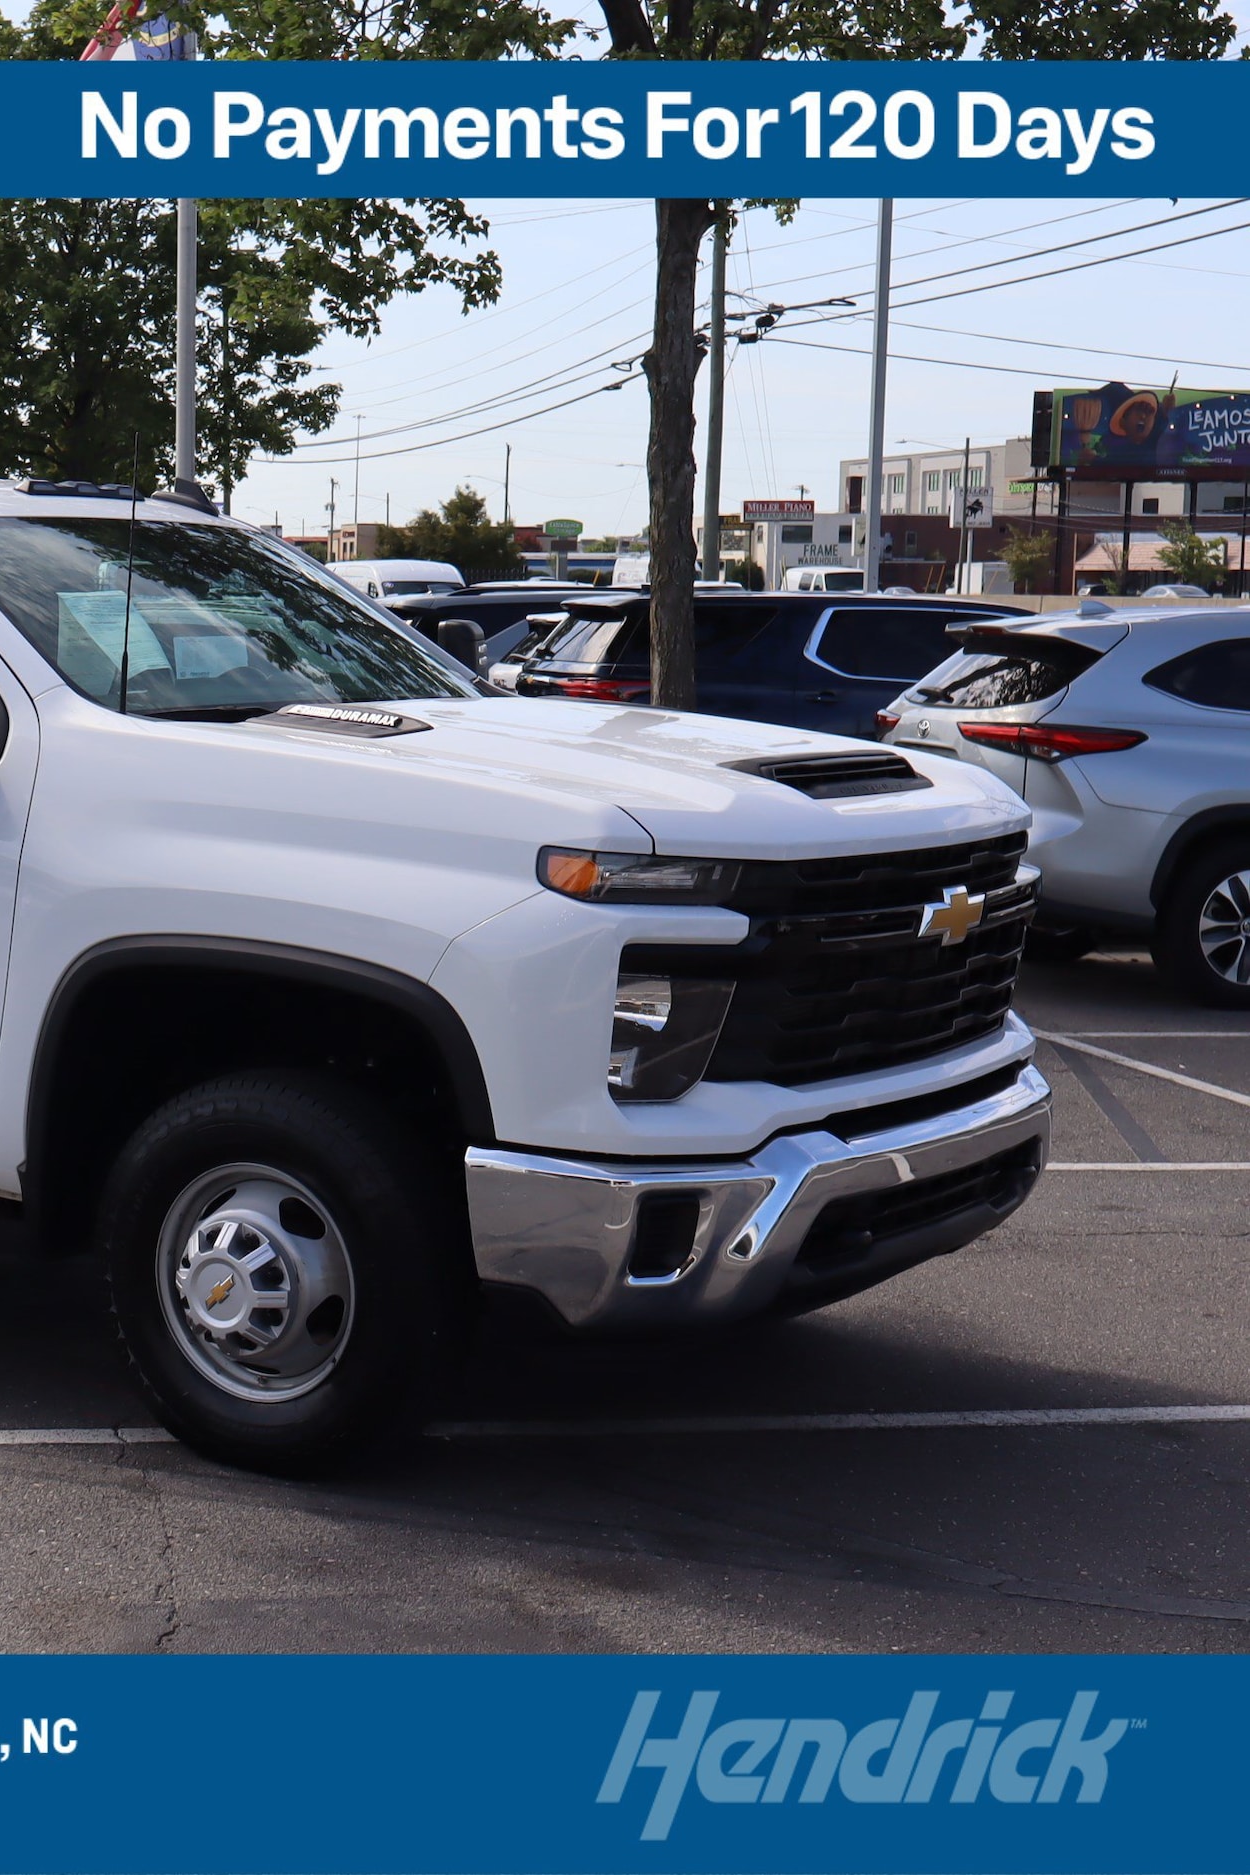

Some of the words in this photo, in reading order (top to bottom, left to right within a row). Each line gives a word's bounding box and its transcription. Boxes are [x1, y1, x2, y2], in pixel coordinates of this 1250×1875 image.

[747, 502, 780, 512] MILLER
[784, 502, 812, 512] PIANO
[803, 544, 839, 557] FRAME
[797, 557, 843, 566] WAREHOUSE
[330, 708, 399, 727] DURAMAX
